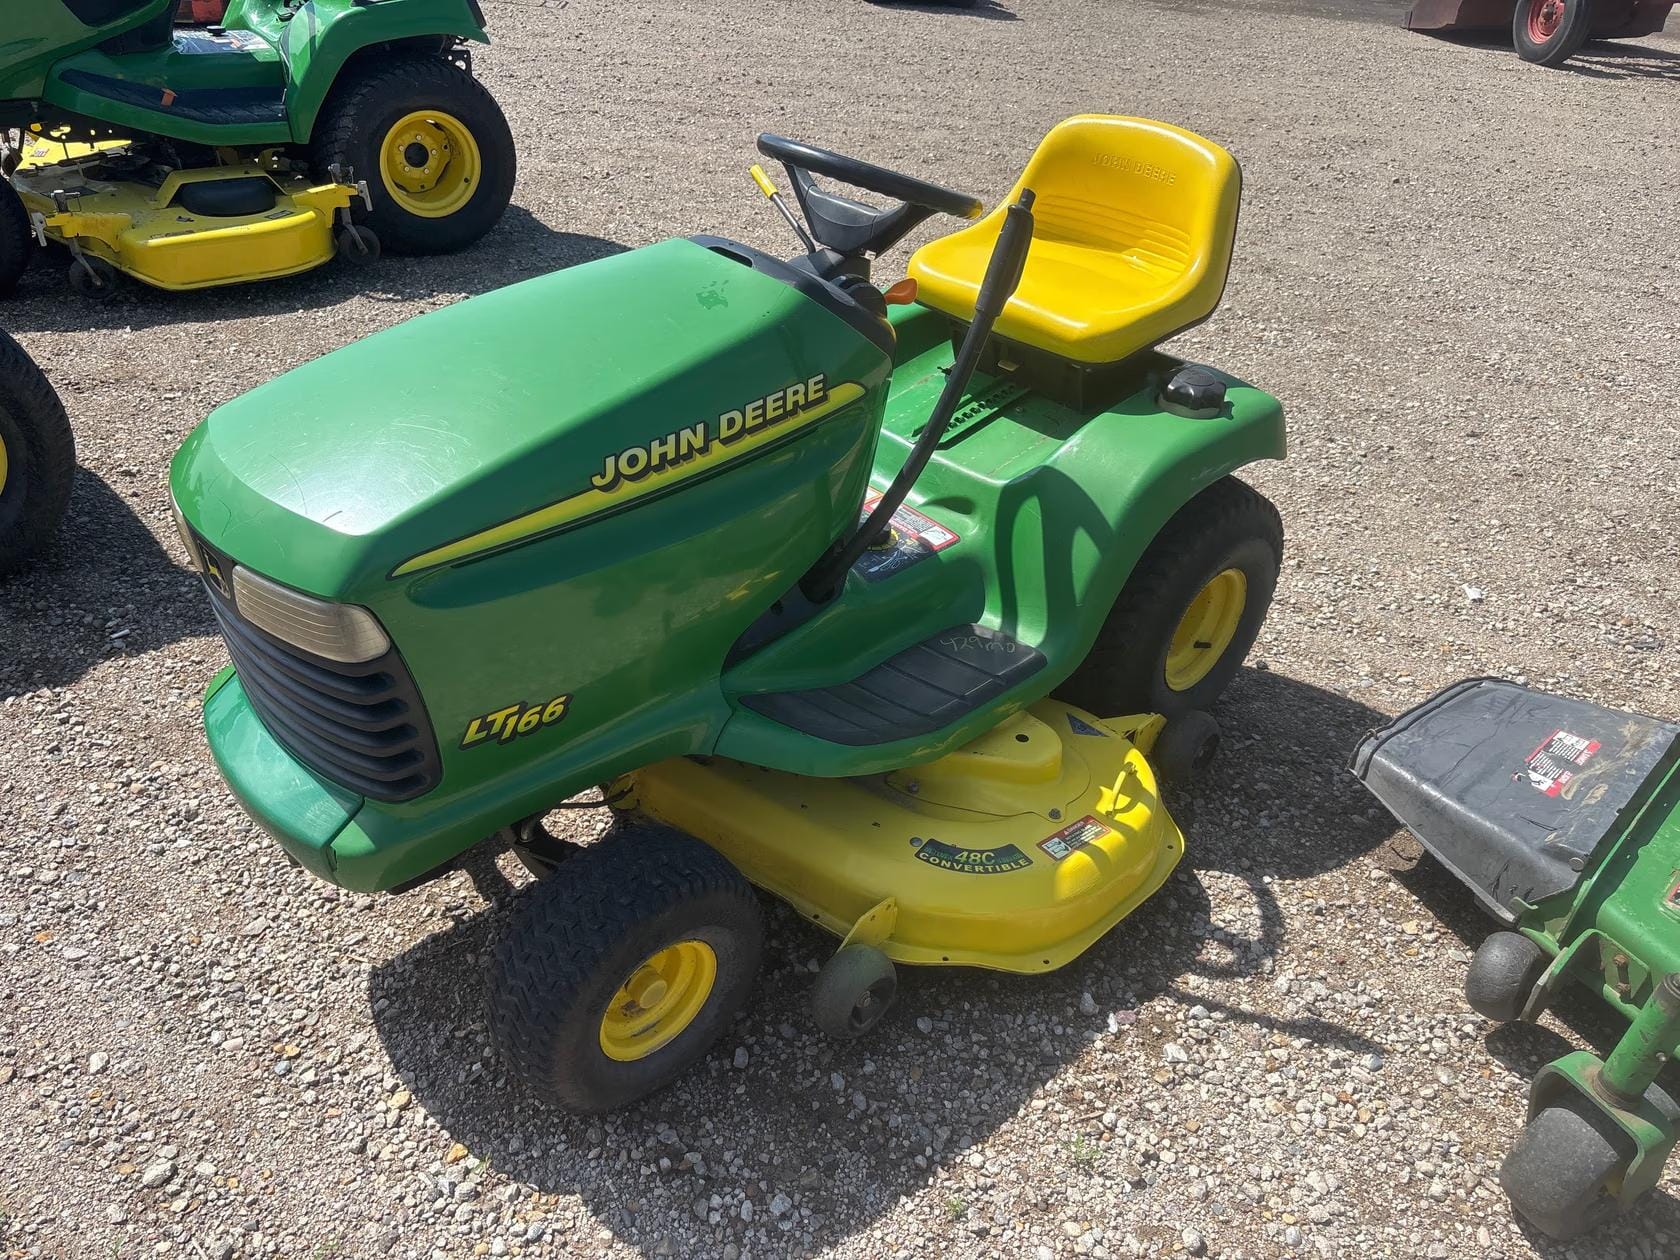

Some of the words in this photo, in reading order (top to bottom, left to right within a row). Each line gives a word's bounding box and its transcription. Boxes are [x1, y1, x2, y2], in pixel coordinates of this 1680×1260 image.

[1092, 152, 1132, 171] JOHN
[1134, 160, 1176, 186] DEERE
[591, 422, 709, 491] JOHN
[717, 372, 827, 443] DEERE
[461, 694, 570, 748] LT166
[918, 852, 1030, 873] CONVERTIBLE
[954, 850, 996, 865] 48C
